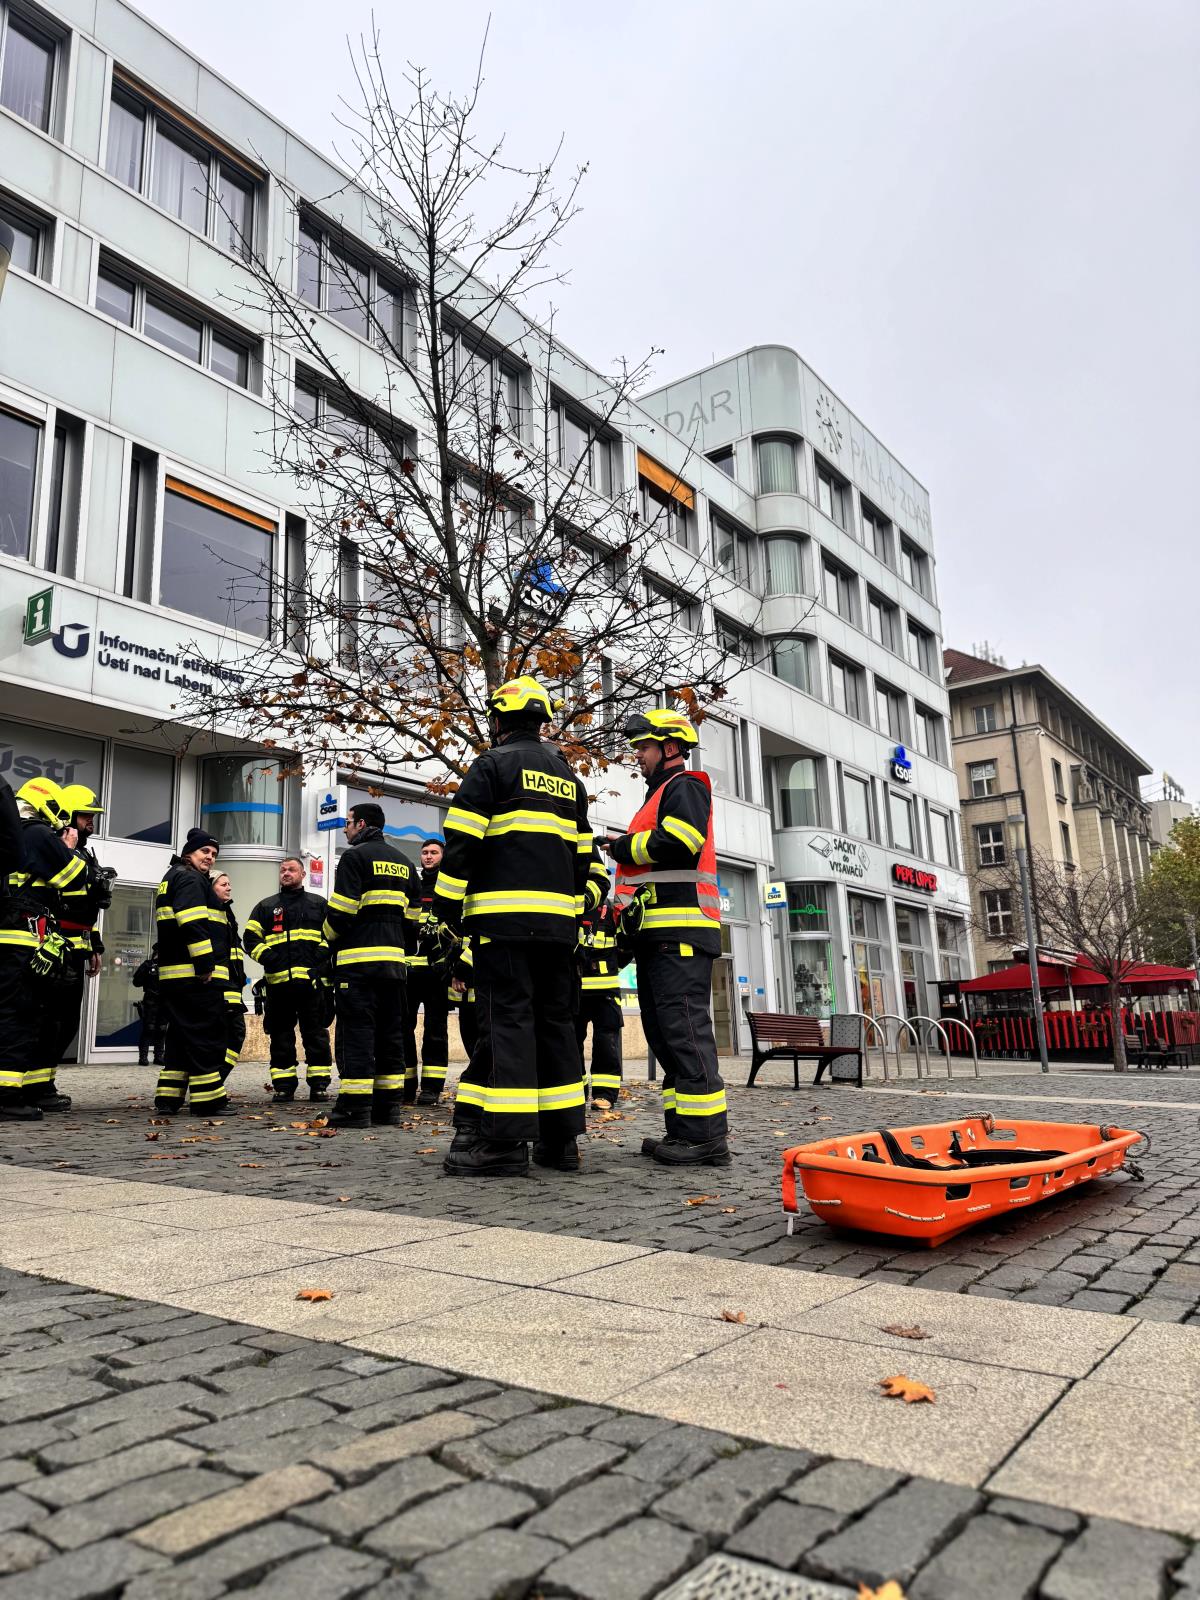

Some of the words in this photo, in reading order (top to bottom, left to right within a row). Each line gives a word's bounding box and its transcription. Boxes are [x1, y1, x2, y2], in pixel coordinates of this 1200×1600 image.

[658, 389, 734, 435] DAR
[99, 630, 179, 666] Informační
[98, 648, 129, 672] Ústí
[133, 663, 160, 680] nad
[164, 669, 212, 694] Labem
[895, 864, 914, 884] PEPE
[915, 870, 938, 892] LOPEZ
